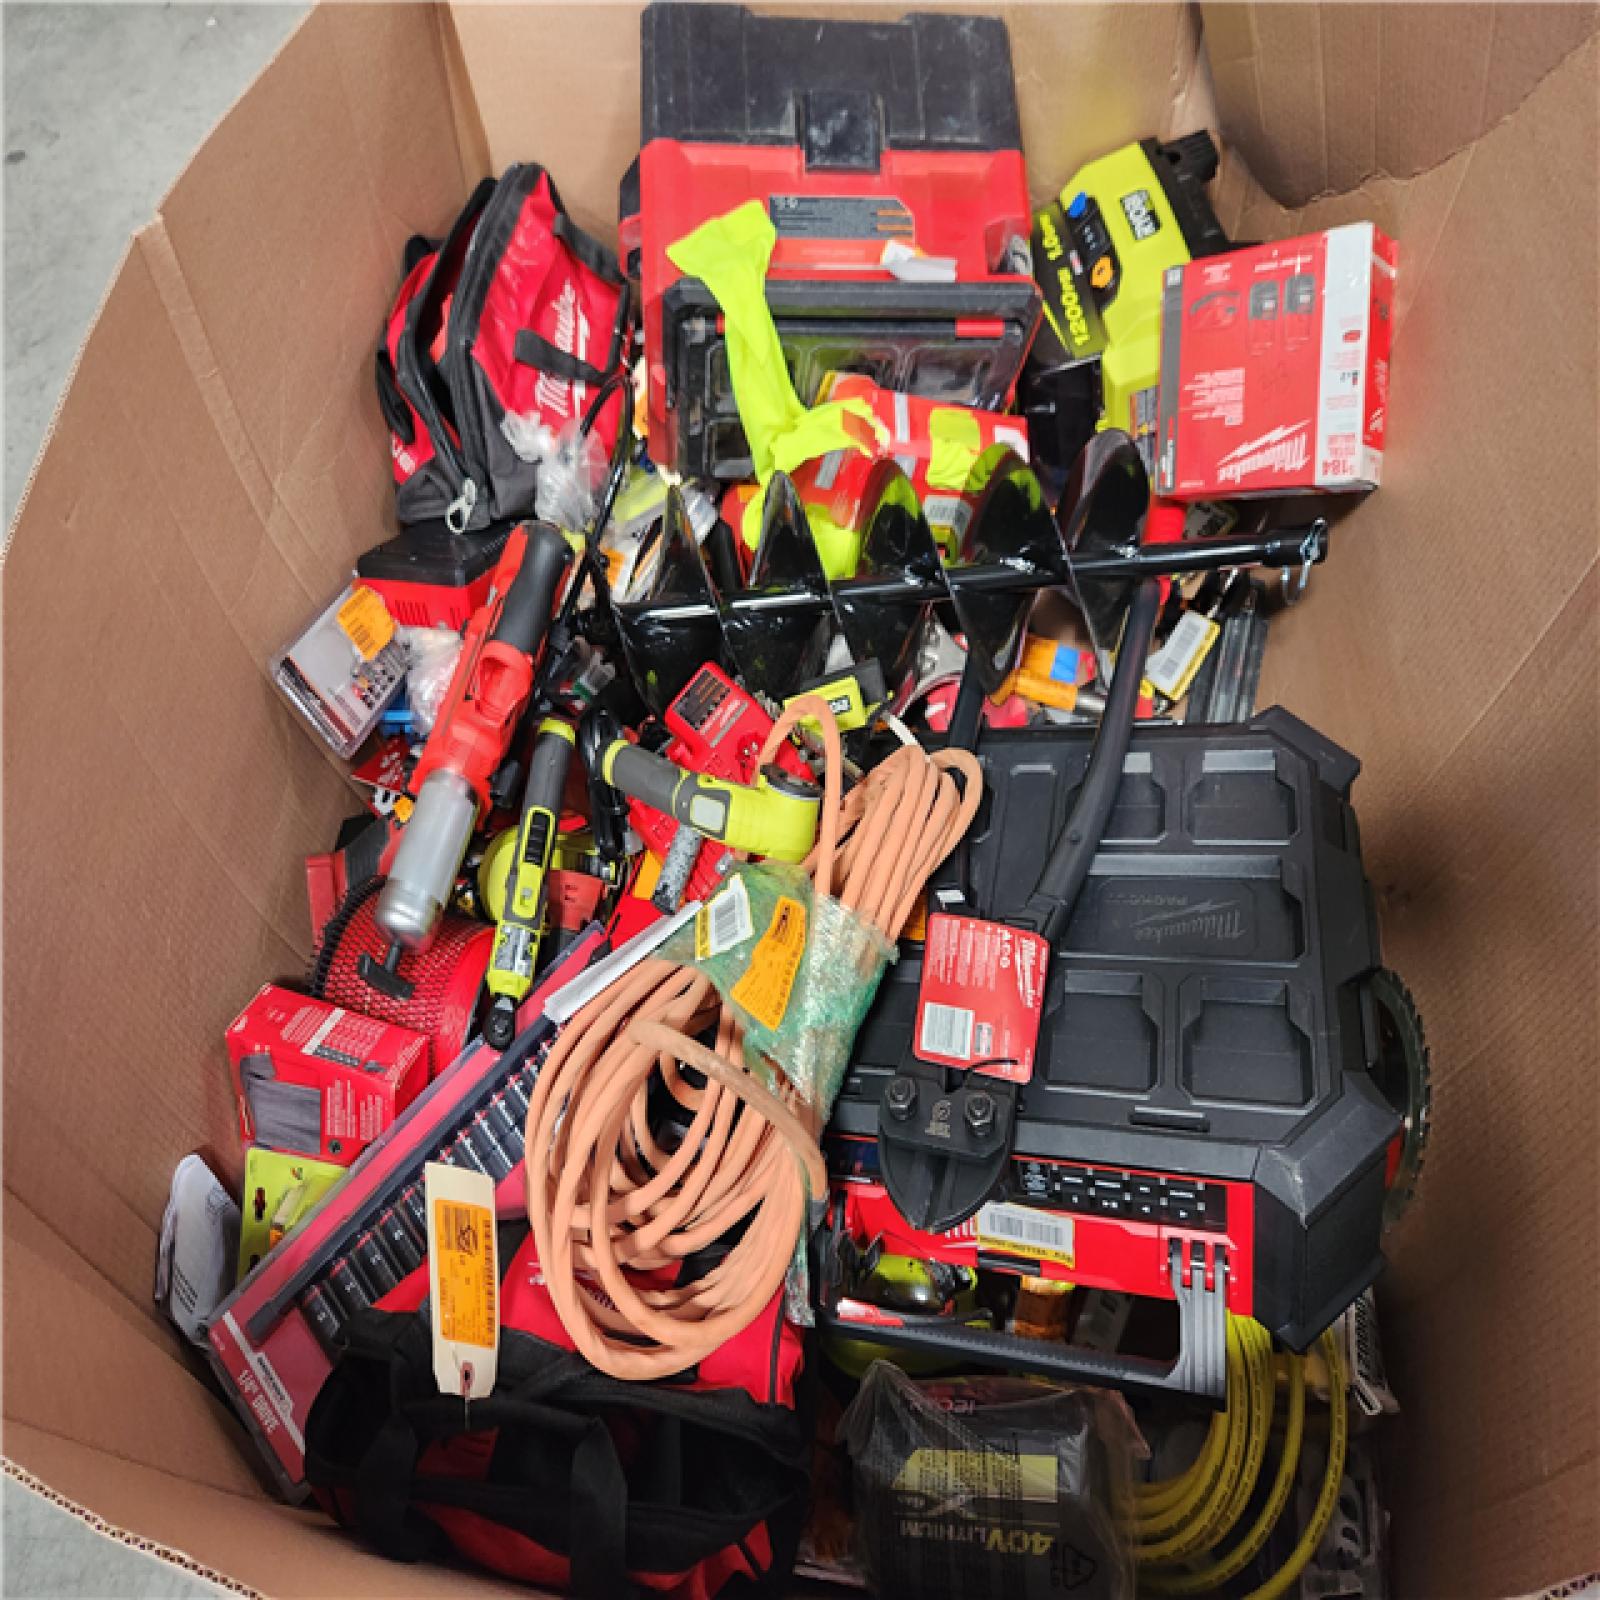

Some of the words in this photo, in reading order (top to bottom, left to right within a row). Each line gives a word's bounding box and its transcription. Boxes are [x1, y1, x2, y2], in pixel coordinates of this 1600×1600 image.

[1122, 190, 1159, 241] RYOBI
[536, 278, 576, 417] Miaukee
[1219, 431, 1311, 484] Milwaukee
[1134, 908, 1246, 944] Milwaukee
[986, 1528, 1055, 1556] 40V
